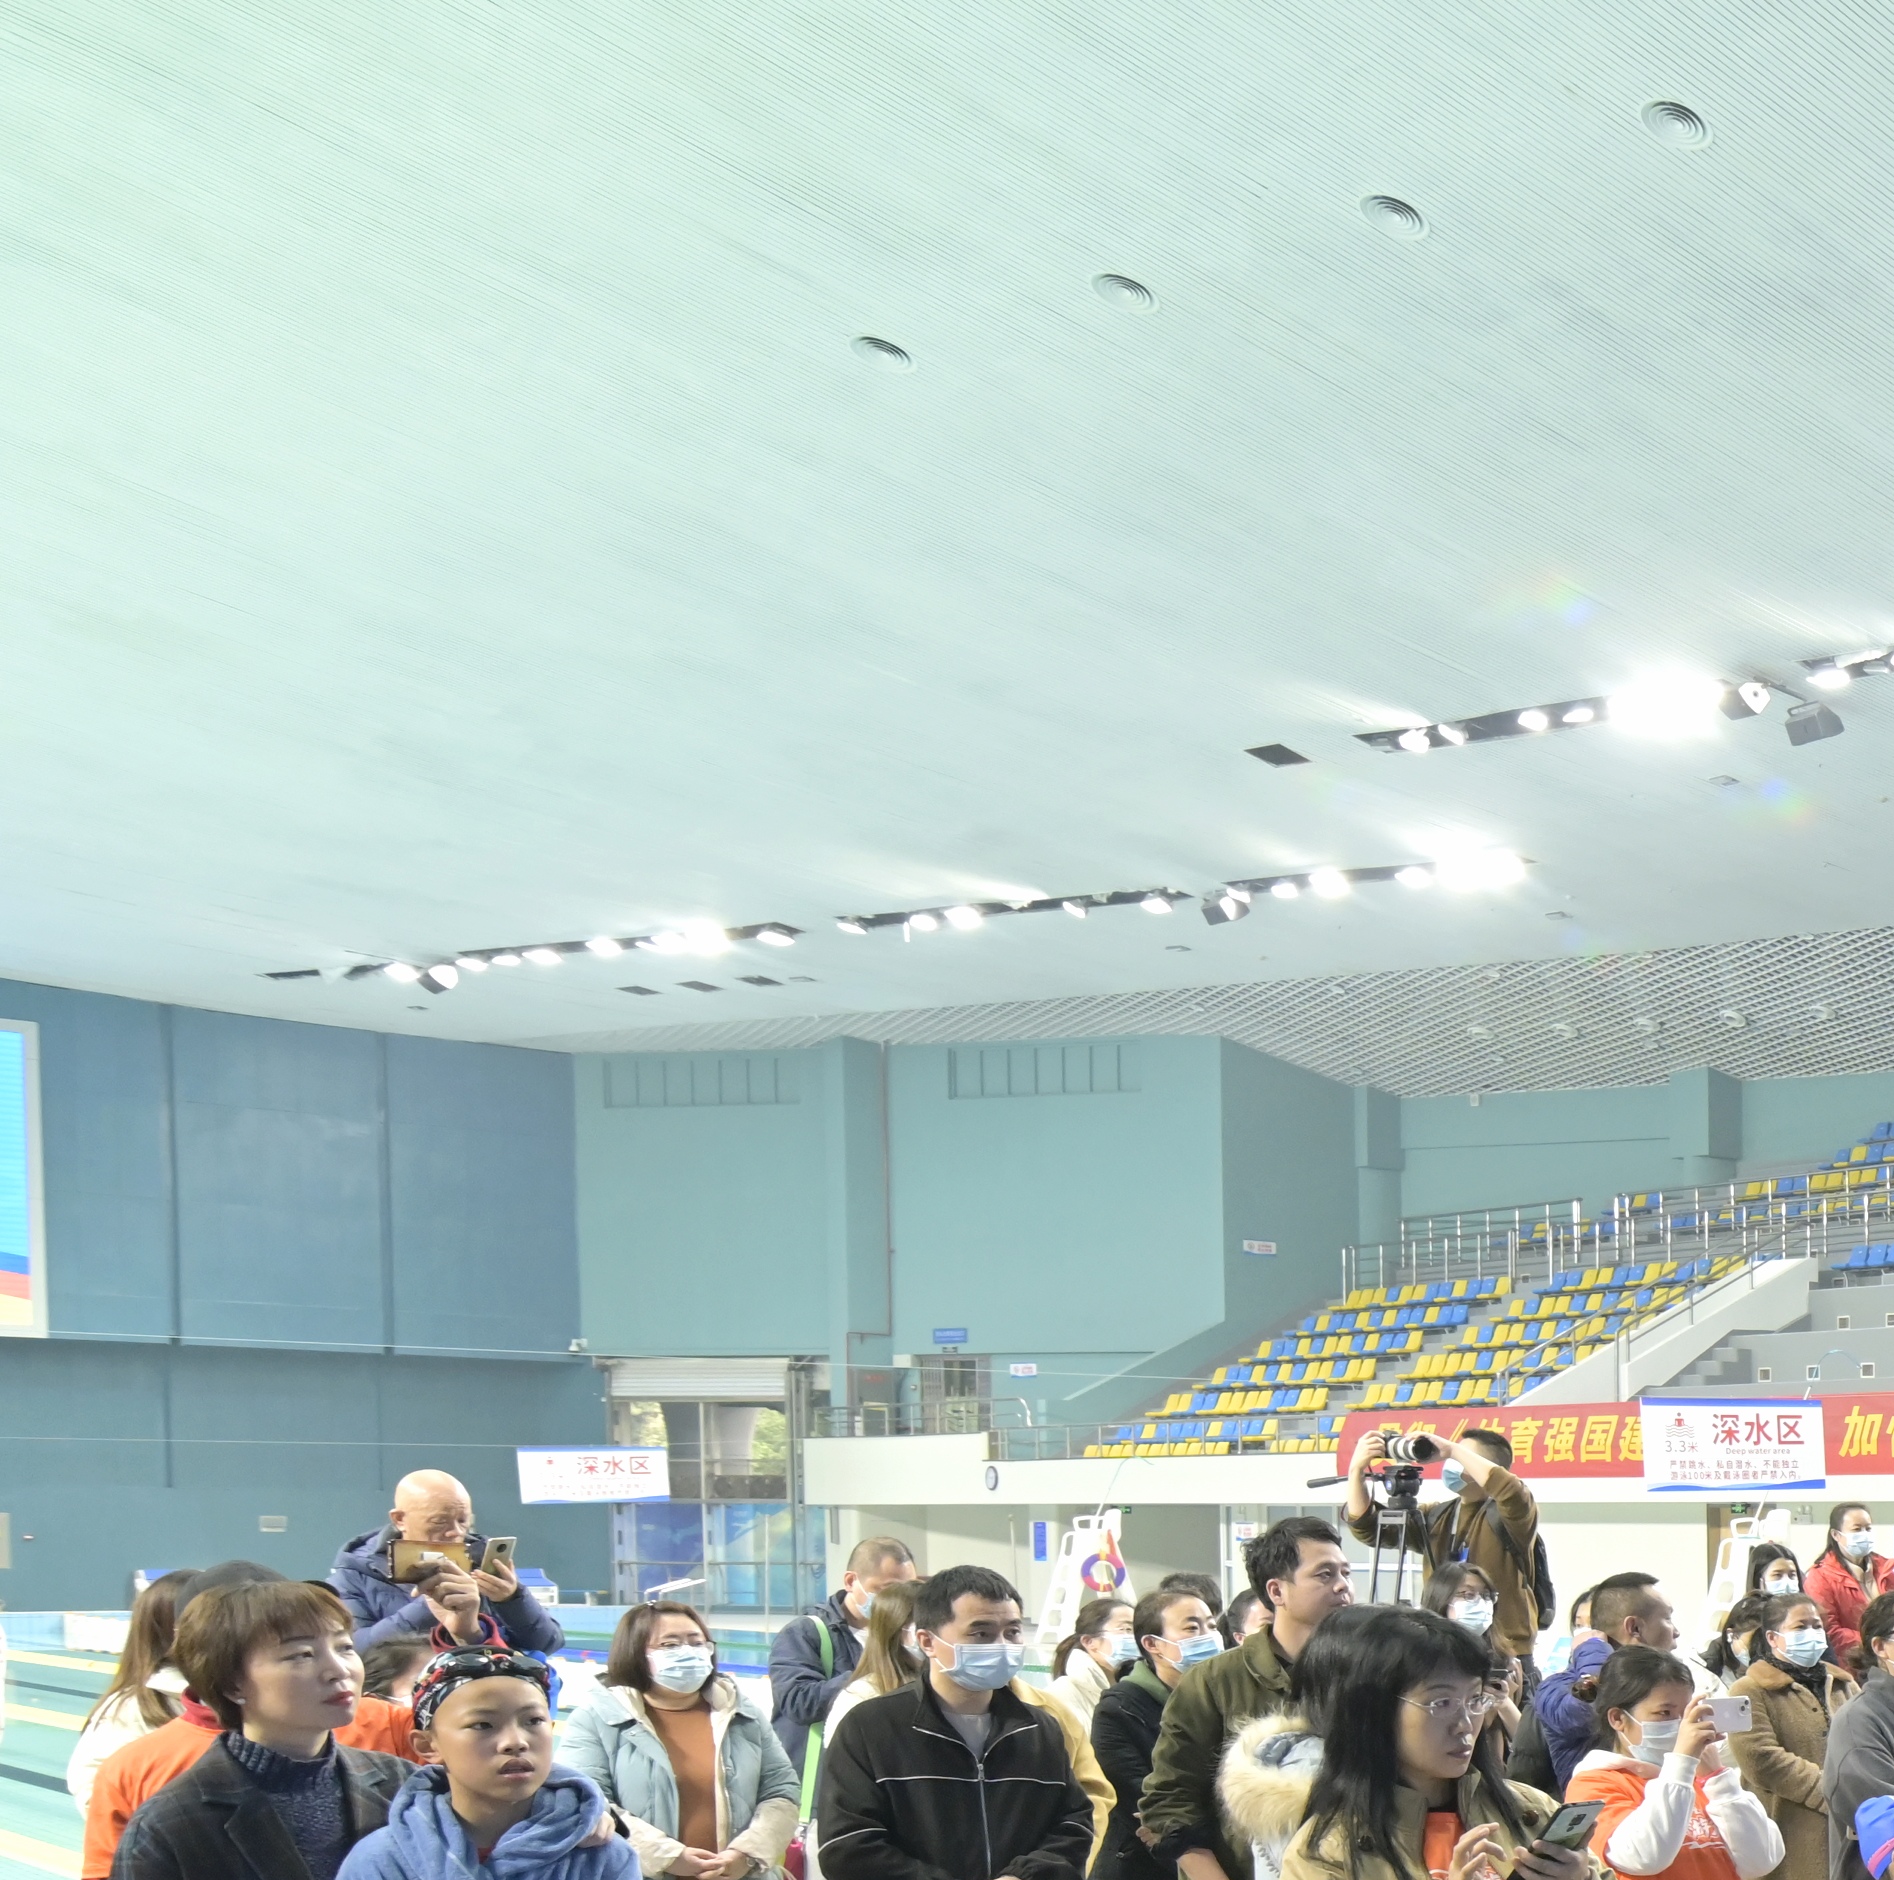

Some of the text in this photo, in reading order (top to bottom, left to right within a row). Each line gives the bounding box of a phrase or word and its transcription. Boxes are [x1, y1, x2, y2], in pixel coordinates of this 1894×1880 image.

[1712, 1413, 1805, 1445] 深水区
[1665, 1440, 1698, 1453] 3.3米
[1726, 1447, 1746, 1456] Deep
[577, 1456, 651, 1475] 深水区
